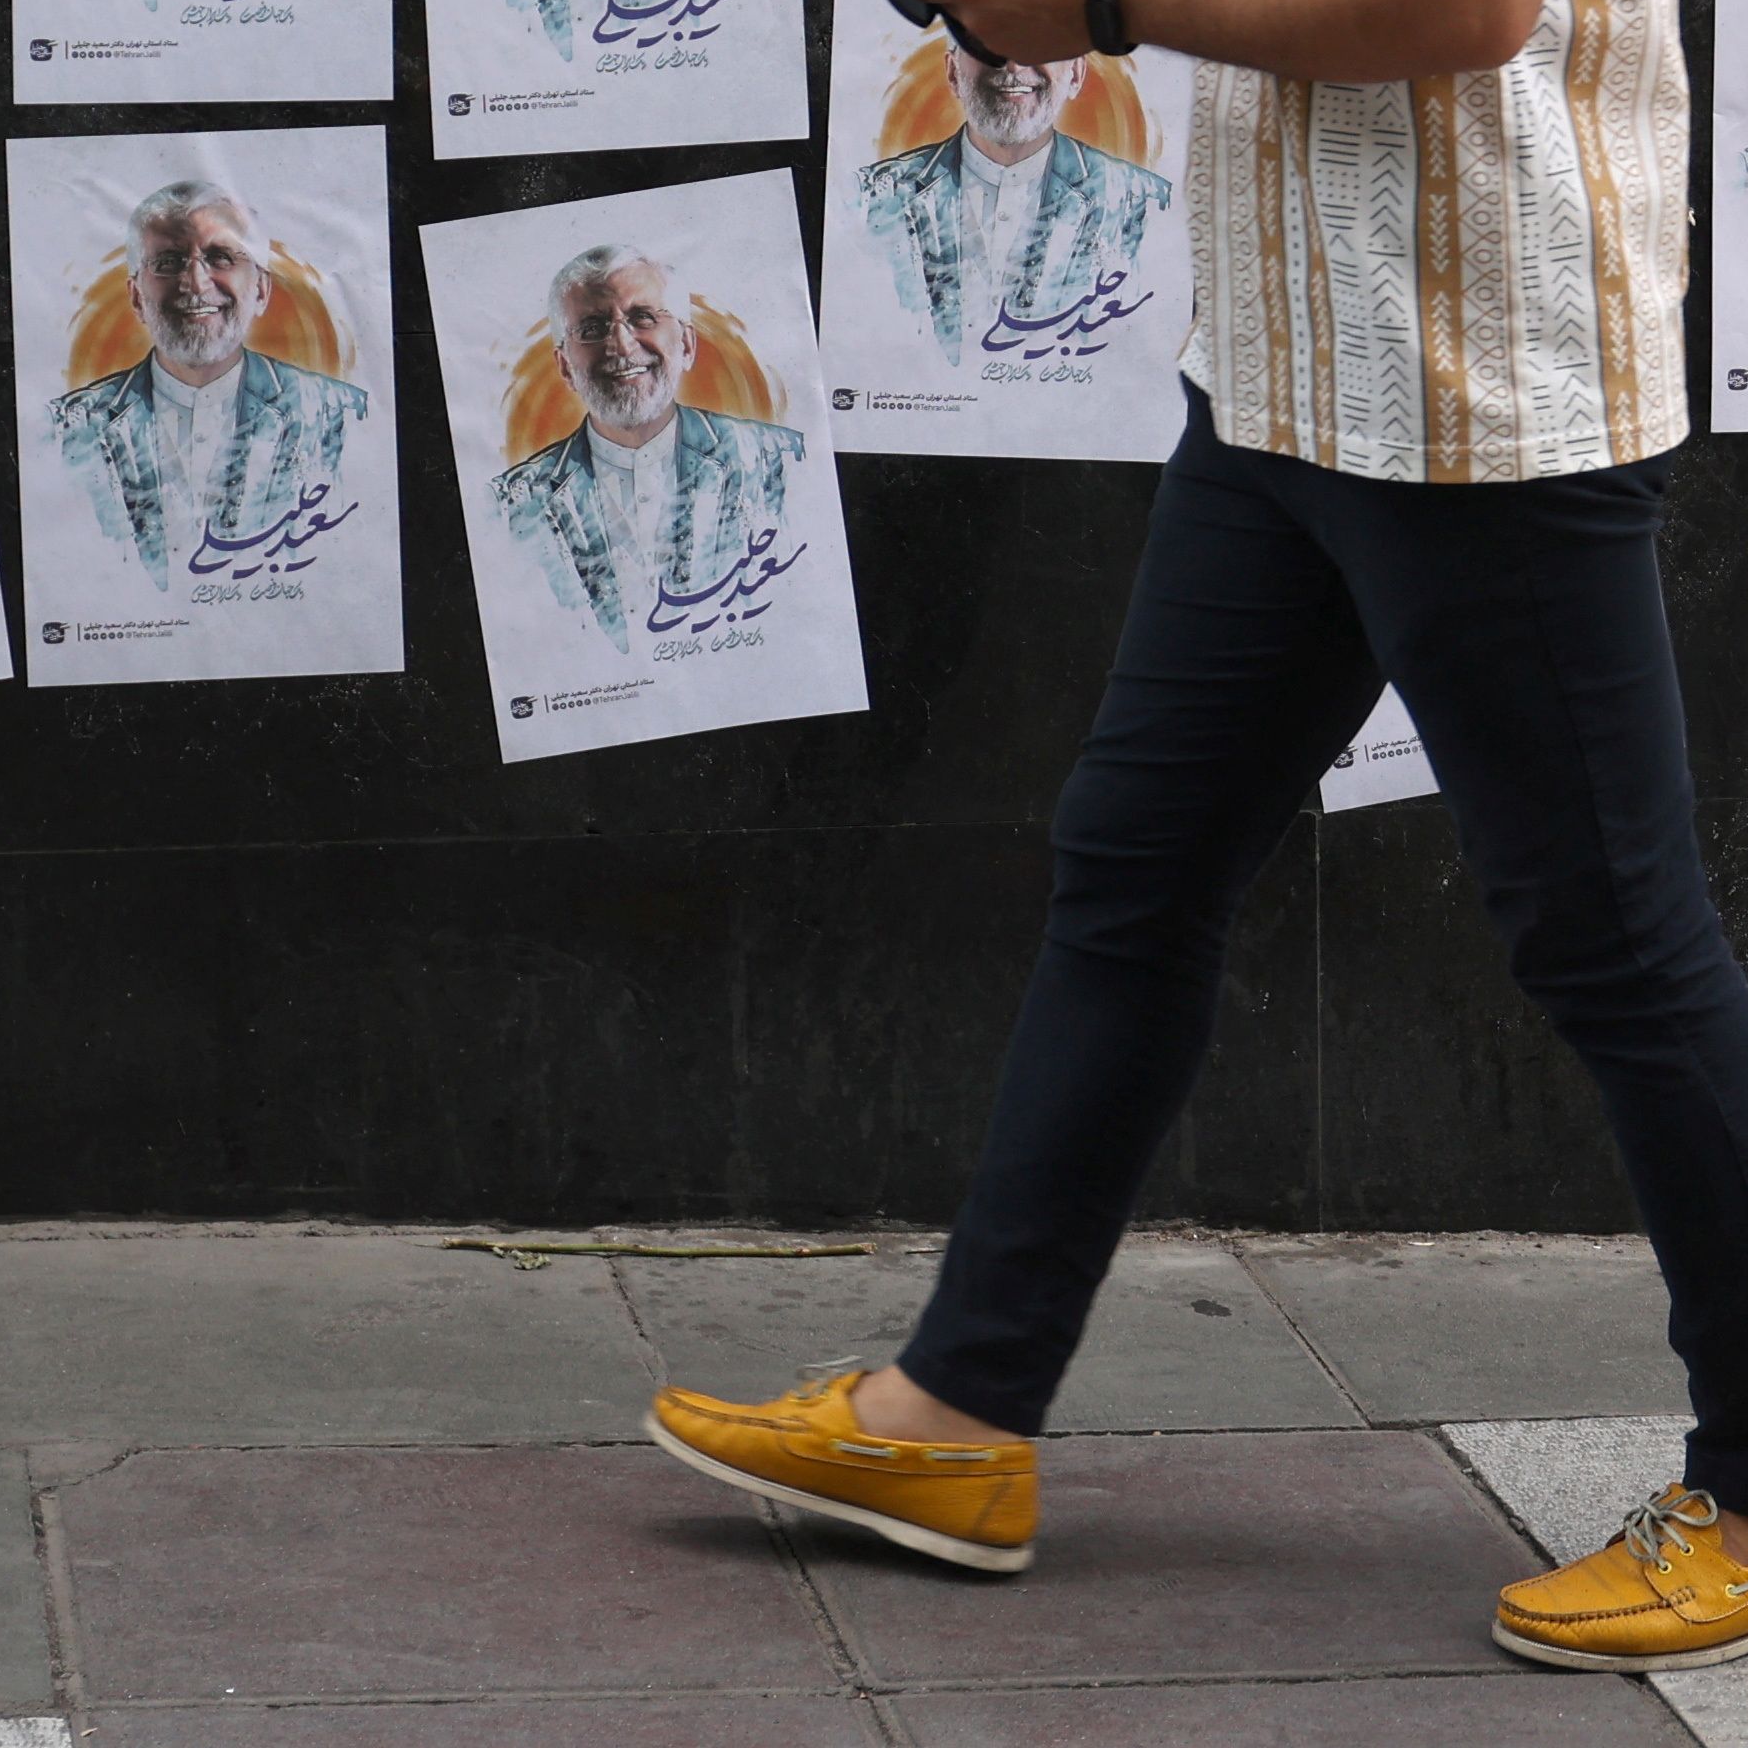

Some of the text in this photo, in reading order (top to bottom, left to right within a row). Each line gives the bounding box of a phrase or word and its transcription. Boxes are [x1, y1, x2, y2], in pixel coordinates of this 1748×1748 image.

[980, 268, 1154, 360] سعید جلیلی
[187, 481, 359, 580] سعید جلیلی
[645, 526, 807, 634] سعید جلیلی
